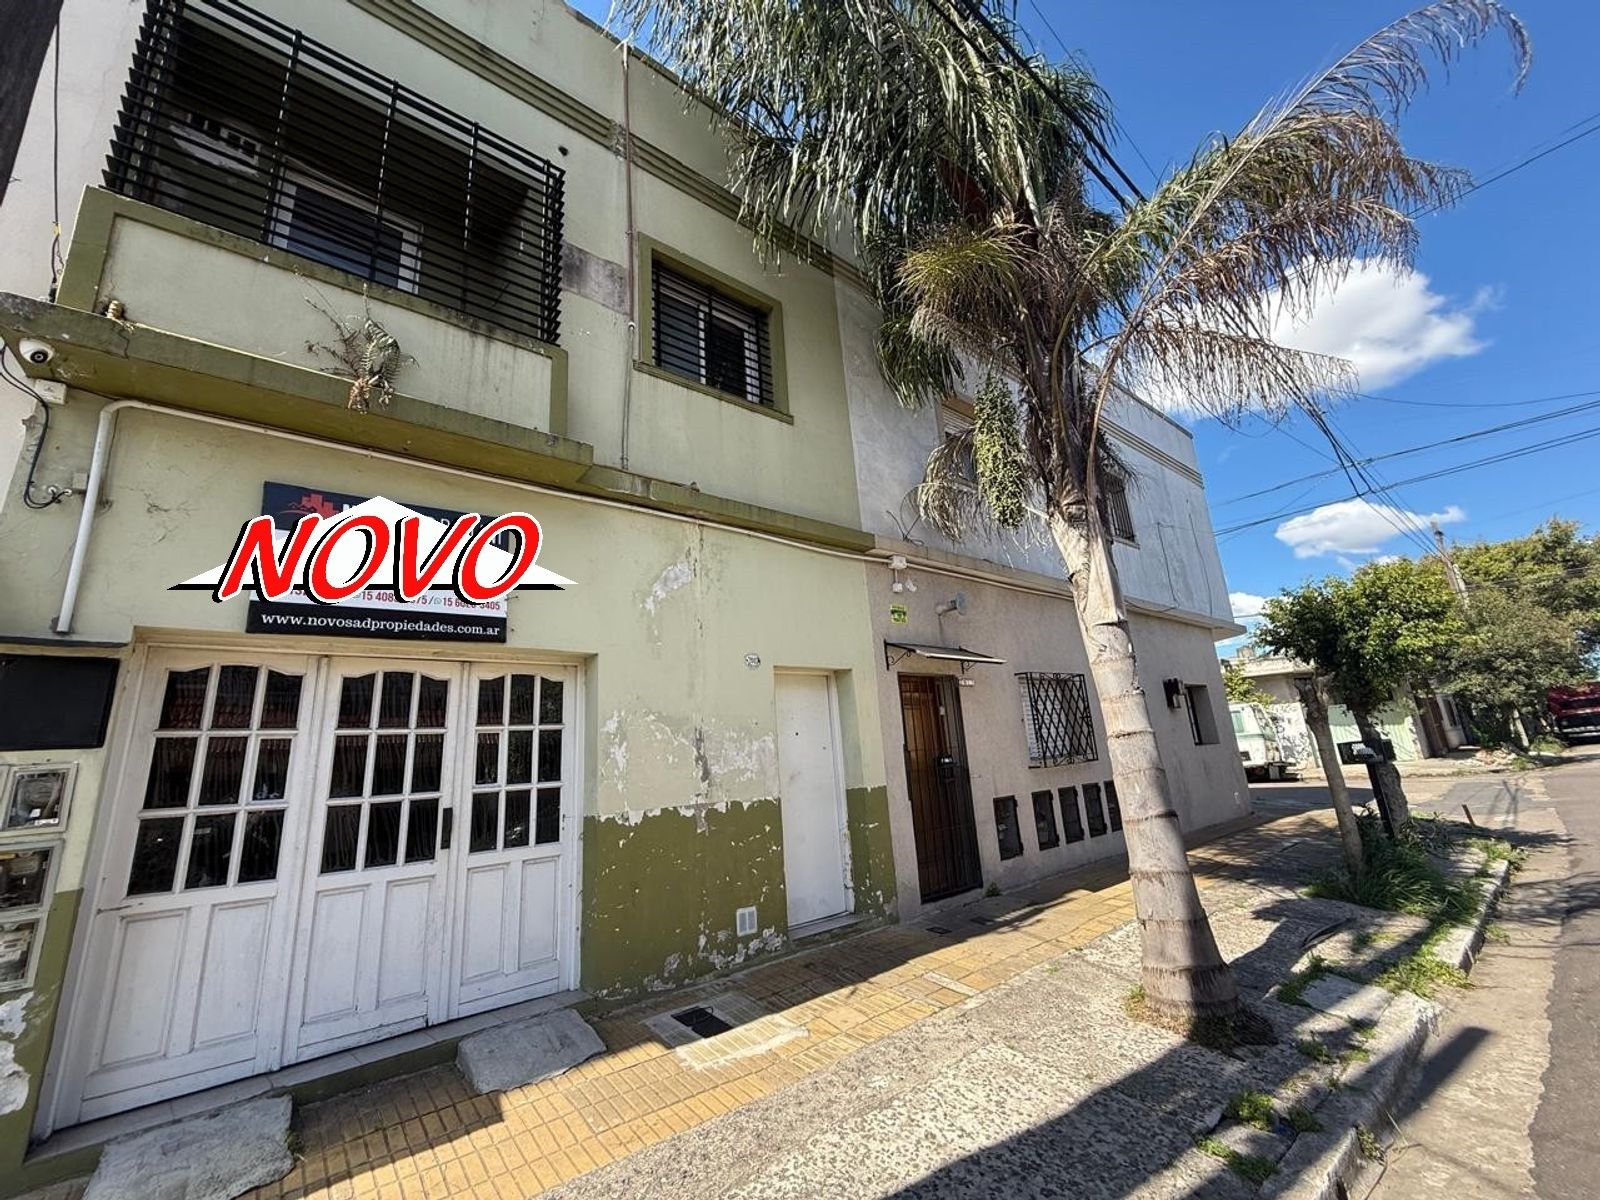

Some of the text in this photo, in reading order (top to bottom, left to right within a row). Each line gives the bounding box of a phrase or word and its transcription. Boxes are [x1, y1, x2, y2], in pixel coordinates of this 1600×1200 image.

[362, 590, 373, 600] 15
[443, 597, 453, 606] 15
[261, 614, 500, 635] www.novosadpropiedades.com.ar
